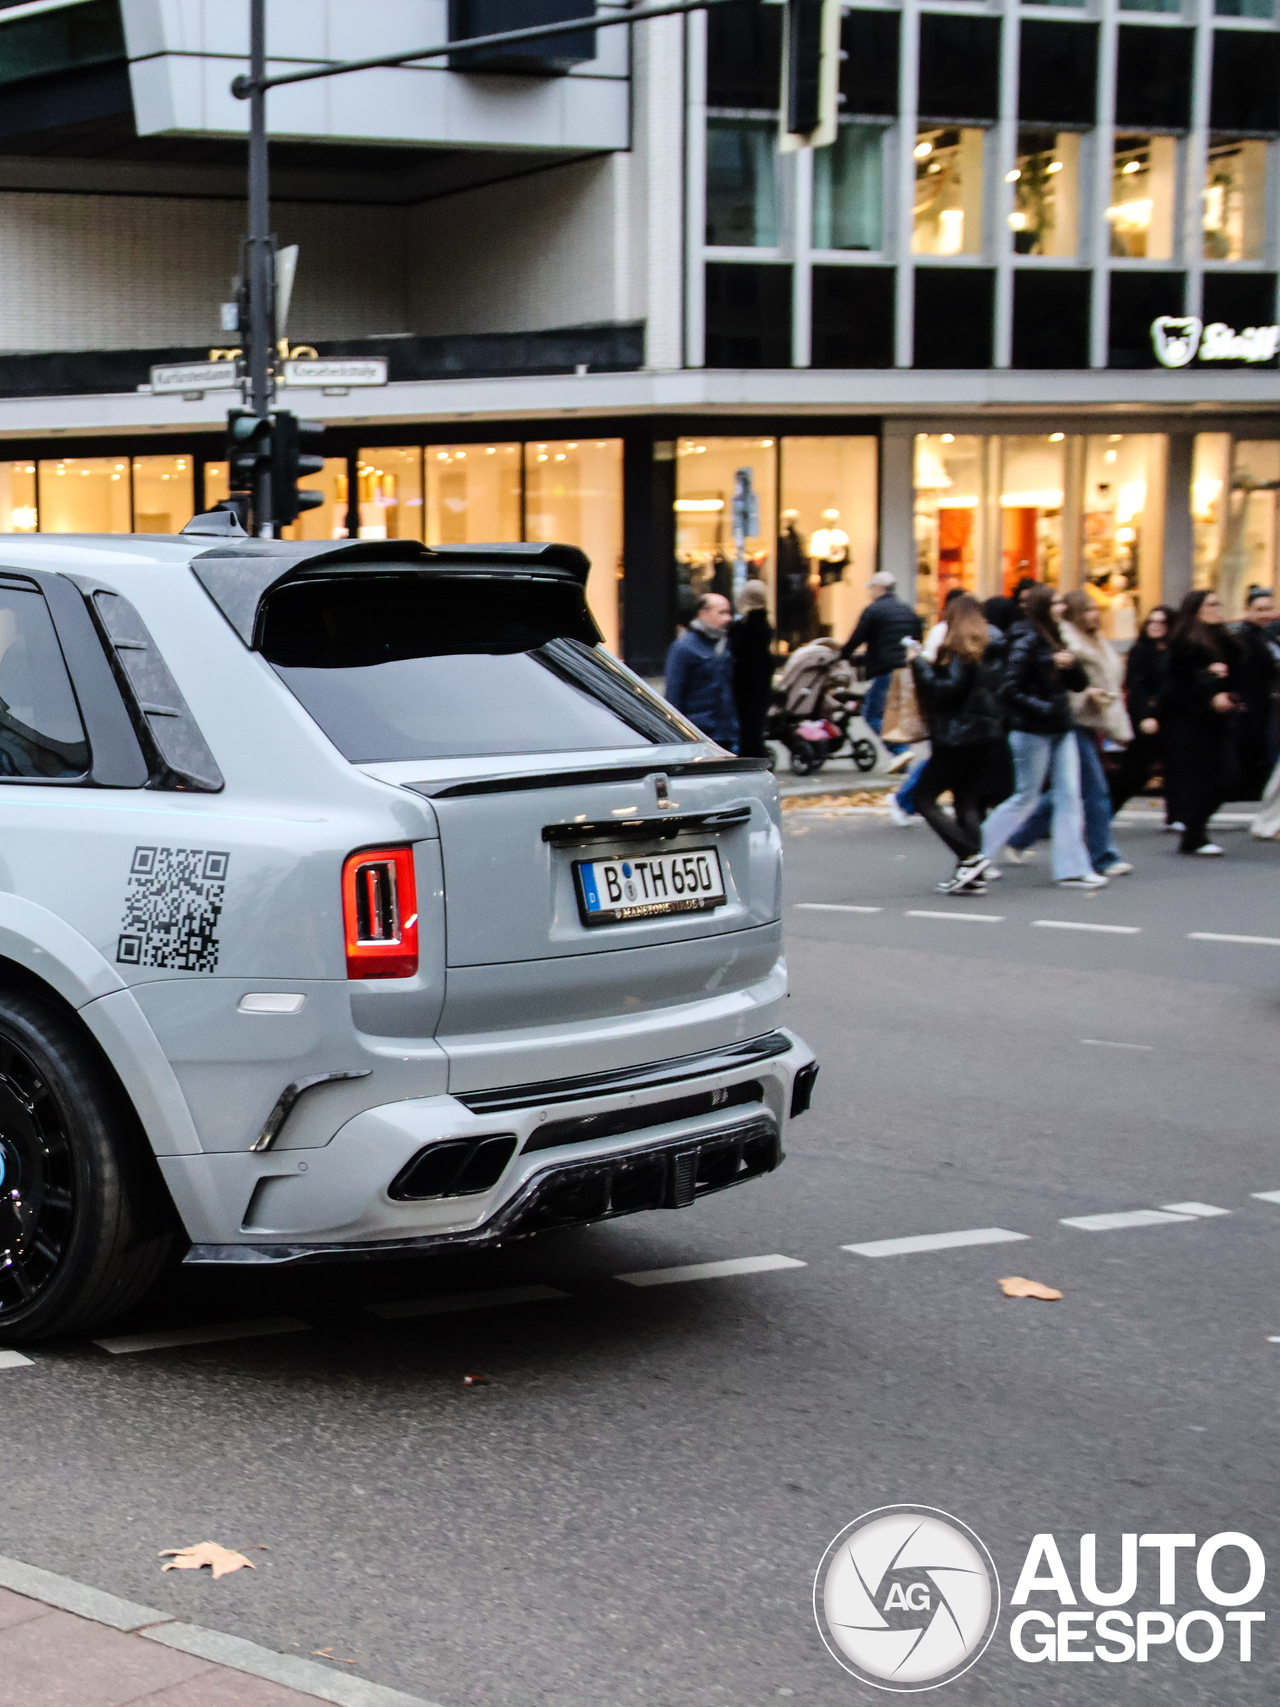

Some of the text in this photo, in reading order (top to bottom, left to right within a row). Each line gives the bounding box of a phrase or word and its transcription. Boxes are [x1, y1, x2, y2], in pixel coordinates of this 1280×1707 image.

[604, 856, 713, 903] B TH 650
